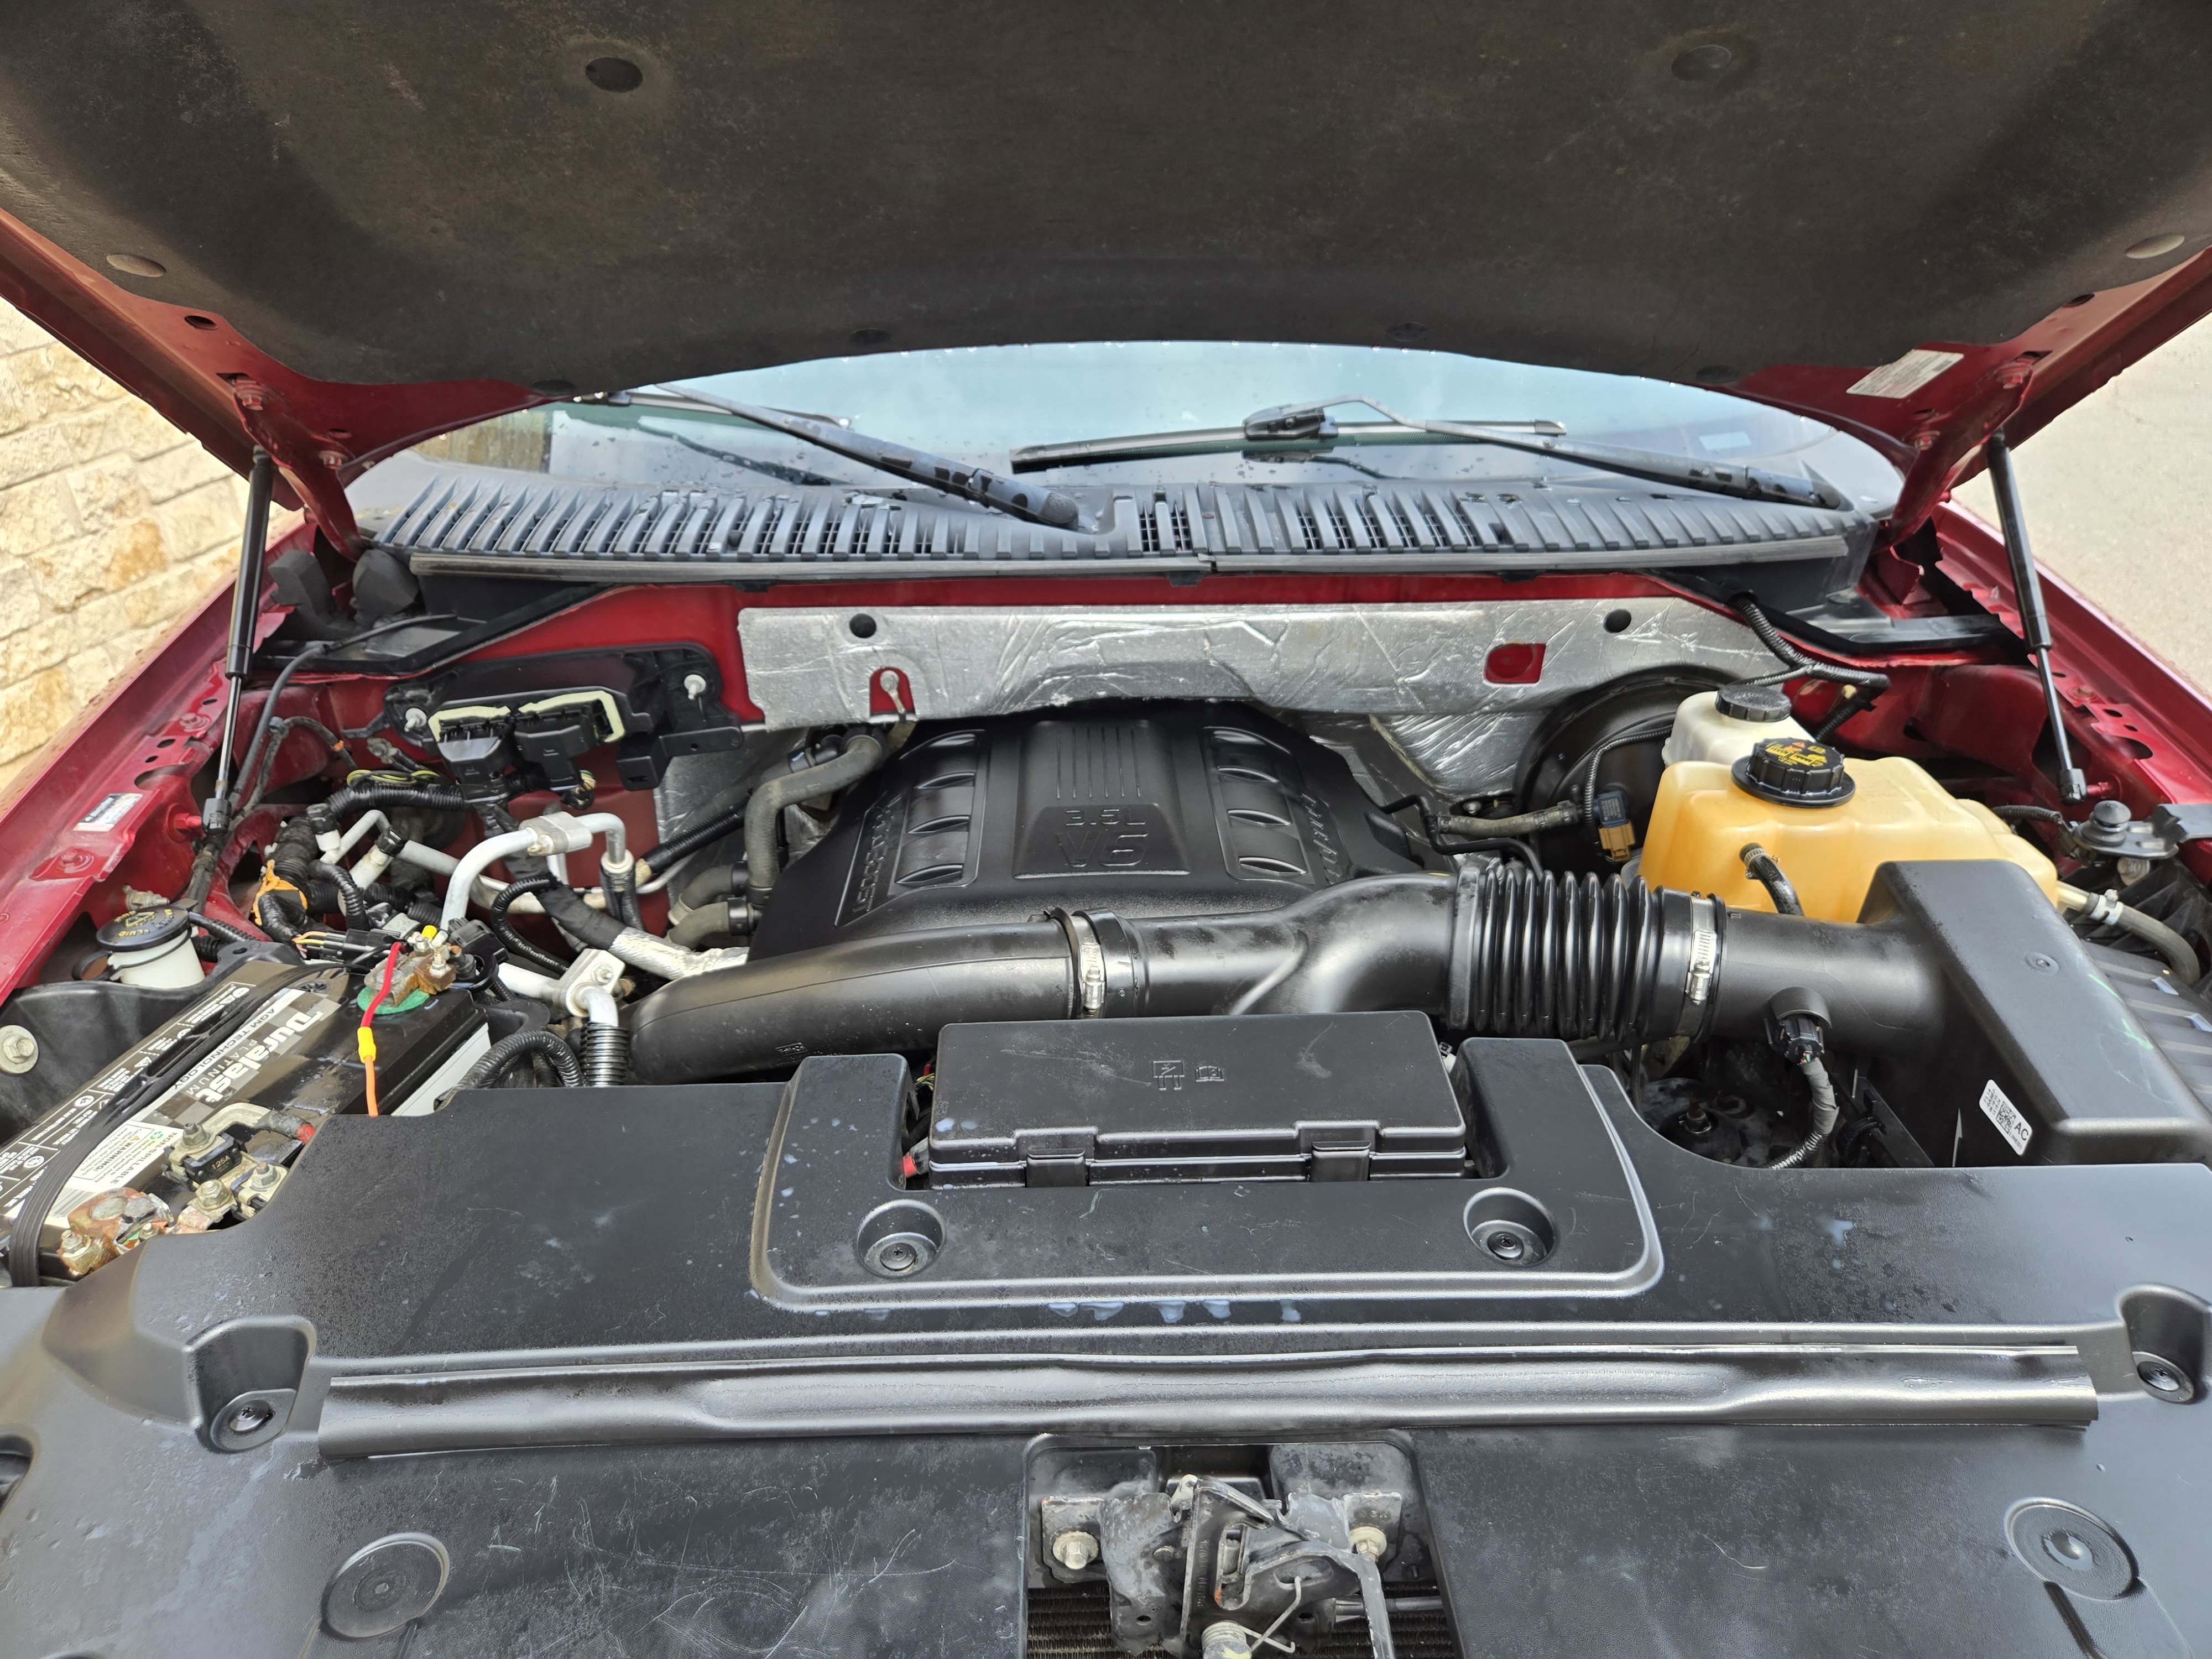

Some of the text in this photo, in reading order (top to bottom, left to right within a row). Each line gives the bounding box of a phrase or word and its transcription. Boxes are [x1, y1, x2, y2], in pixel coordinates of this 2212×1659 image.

[1065, 809, 1146, 826] 3.5L
[1056, 831, 1149, 867] V6
[250, 1008, 275, 1028] AGM
[174, 1030, 251, 1089] TECHNOLOGY
[186, 1039, 258, 1095] PLATINUM
[195, 1011, 324, 1102] Duralast
[2014, 1122, 2028, 1141] AC
[110, 1132, 178, 1183] NON-SPILLABLE
[212, 1155, 230, 1170] 125A
